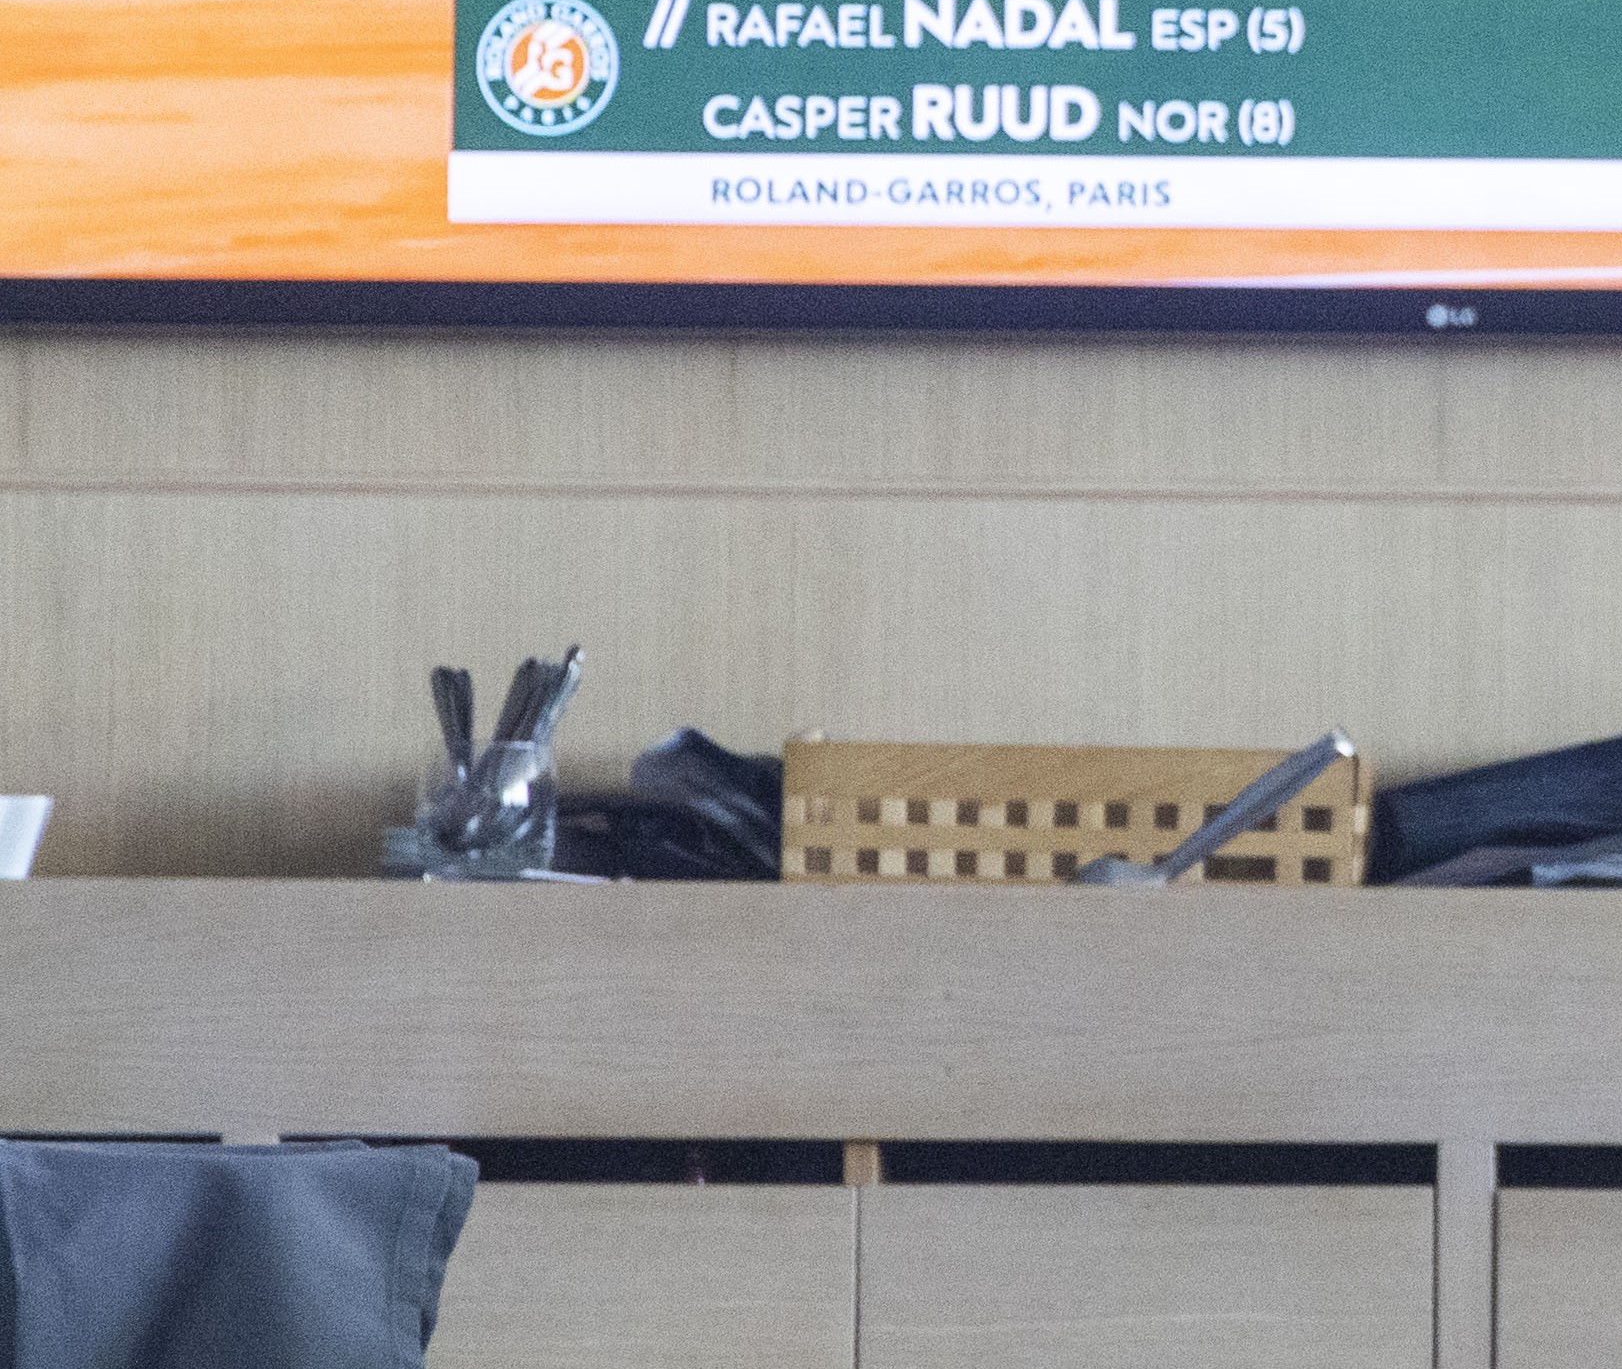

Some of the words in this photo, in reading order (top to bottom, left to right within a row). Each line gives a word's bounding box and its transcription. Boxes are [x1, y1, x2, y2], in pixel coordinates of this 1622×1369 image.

[706, 3, 896, 48] RAFAEL
[1150, 8, 1239, 52] ESP
[1247, 6, 1306, 55] (5)
[702, 94, 902, 141] CASPER
[911, 83, 1101, 142] RUUD
[1117, 99, 1231, 145] NOR
[1237, 99, 1296, 147] (8)
[711, 176, 1054, 212] ROLAND-GARROS,
[1068, 179, 1172, 208] PARIS
